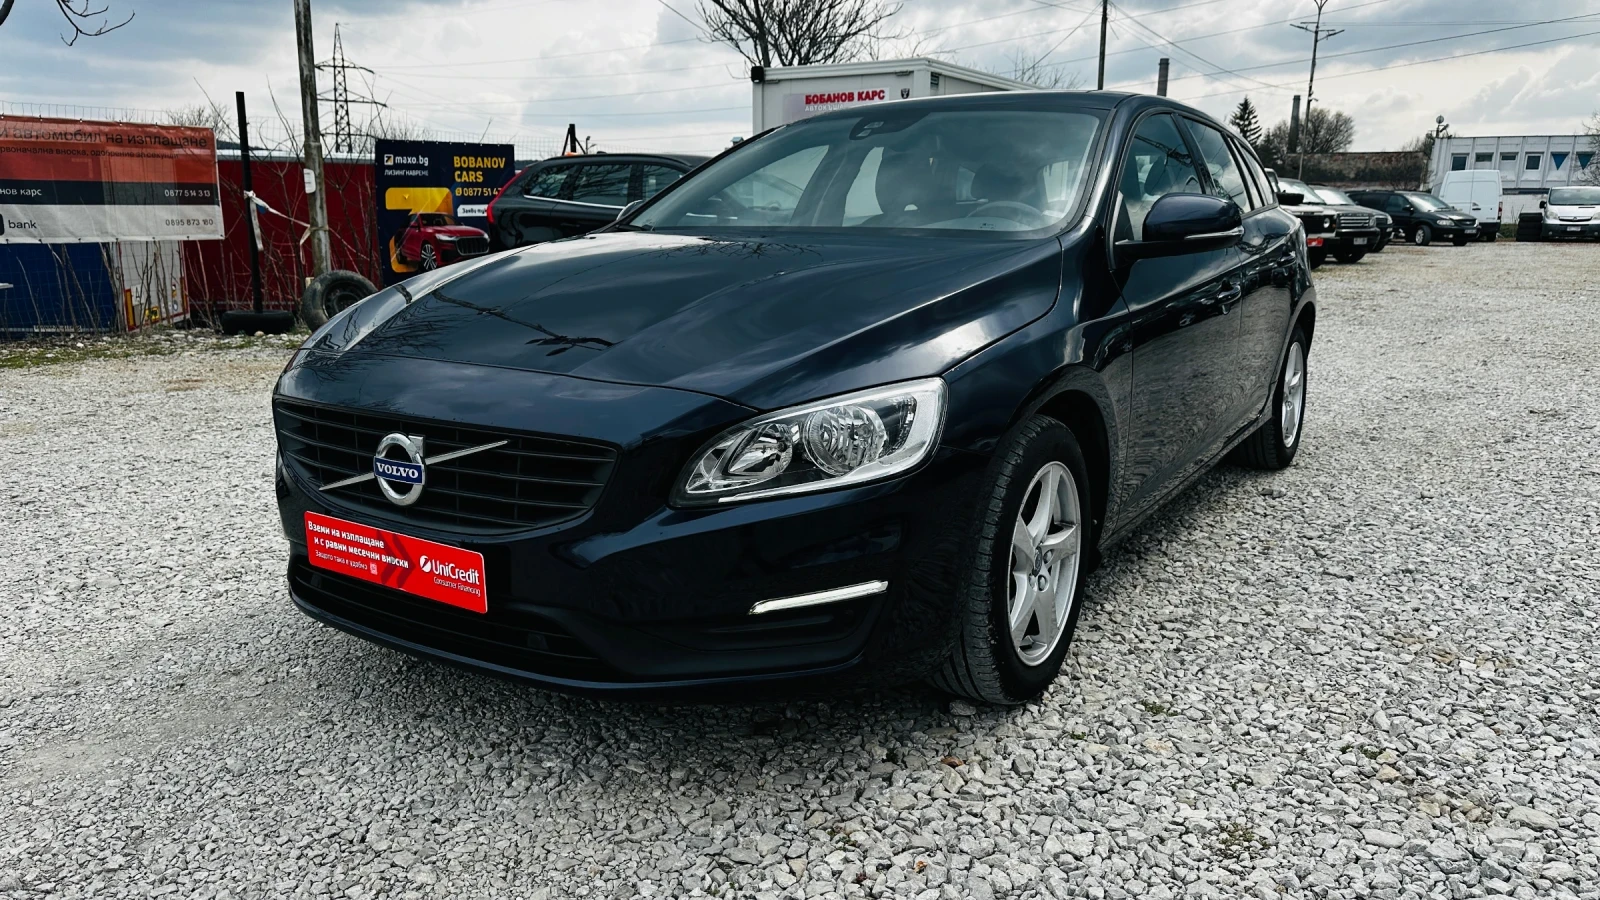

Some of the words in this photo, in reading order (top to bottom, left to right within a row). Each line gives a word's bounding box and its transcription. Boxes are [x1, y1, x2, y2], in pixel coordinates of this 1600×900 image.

[805, 92, 854, 105] БОБАНОВ
[857, 89, 885, 101] КАРС
[13, 129, 101, 142] автомобил
[105, 134, 123, 144] на
[127, 135, 207, 148] изплащане
[395, 154, 429, 166] maxo.bg
[453, 156, 506, 168] BOBANOV
[454, 171, 484, 182] CARS
[20, 189, 42, 197] карс
[164, 189, 183, 197] 0877
[198, 189, 211, 197] 313
[463, 187, 482, 196] 0877
[8, 219, 37, 229] bank
[165, 218, 185, 226] 0895
[186, 218, 200, 226] 873
[376, 462, 419, 479] VOLVO
[307, 520, 330, 535] Вземи
[331, 528, 340, 538] на
[341, 530, 384, 549] изплащане
[313, 536, 320, 545] и
[325, 539, 347, 552] равни
[348, 546, 380, 561] месечни
[381, 554, 409, 569] вноски
[432, 559, 480, 585] UniCredit
[434, 576, 457, 589] Consumer
[458, 582, 481, 597] Financing
